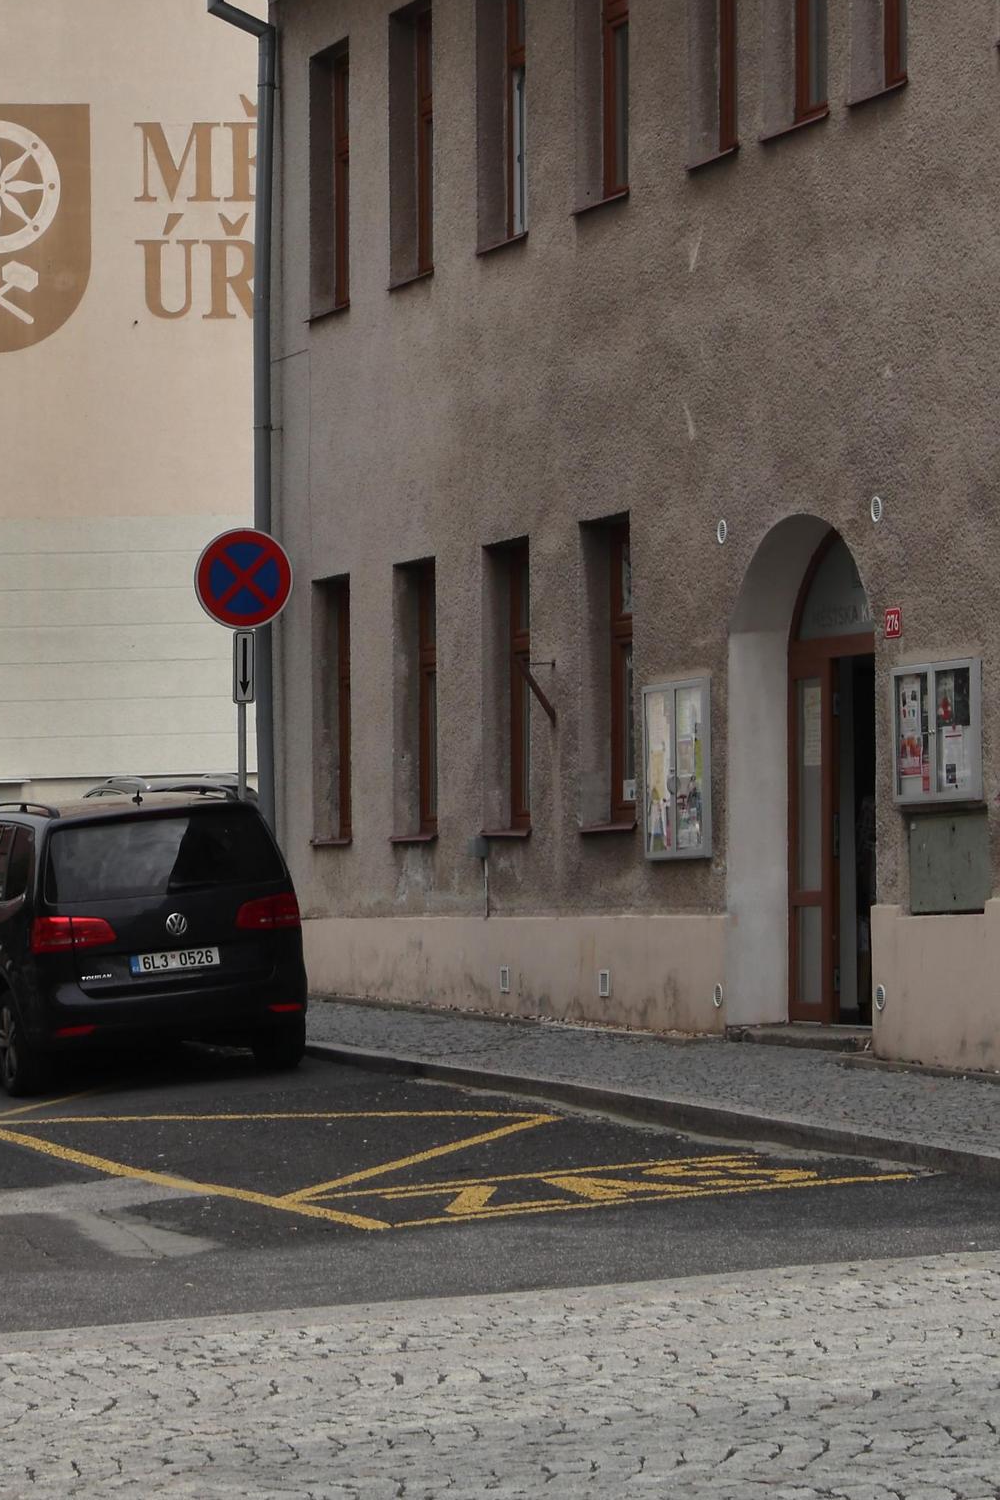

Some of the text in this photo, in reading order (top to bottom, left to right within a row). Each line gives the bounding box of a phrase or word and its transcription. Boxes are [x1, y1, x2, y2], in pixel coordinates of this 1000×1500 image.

[886, 614, 899, 631] 276
[142, 954, 169, 970] 6L3
[178, 949, 214, 966] 0526
